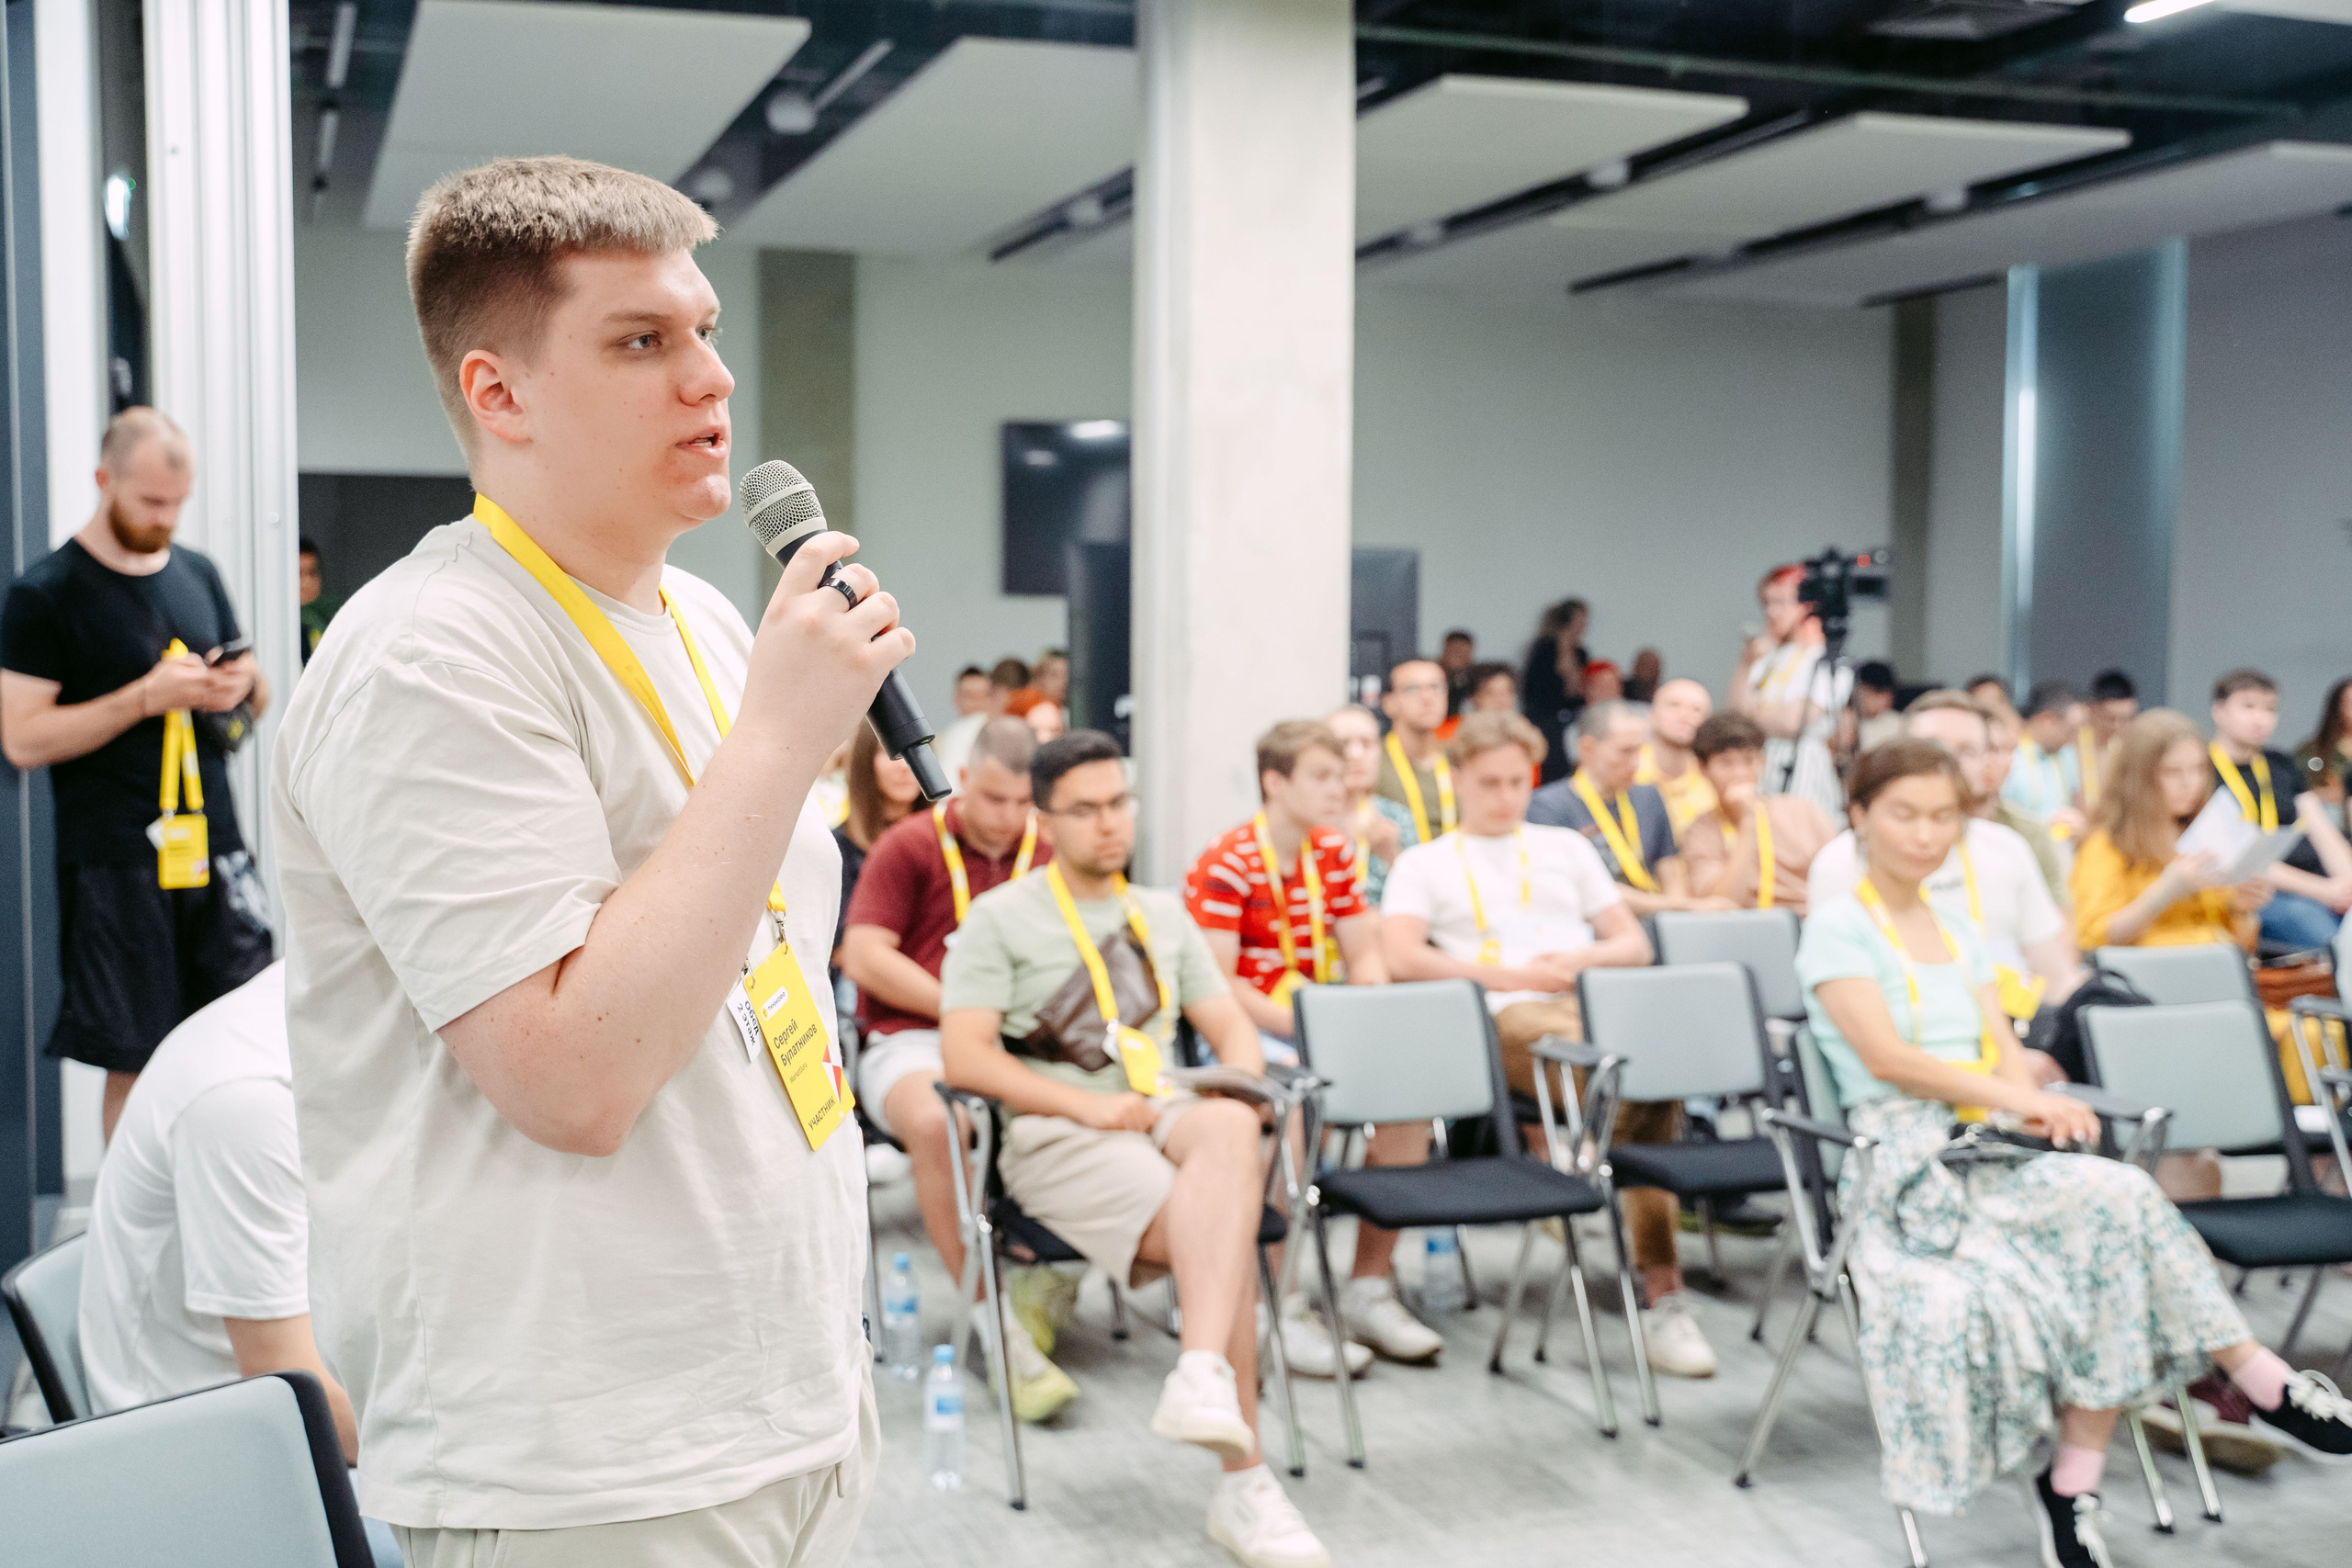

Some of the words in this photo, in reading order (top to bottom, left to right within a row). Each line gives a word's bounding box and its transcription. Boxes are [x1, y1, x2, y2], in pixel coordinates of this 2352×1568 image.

[738, 1003, 743, 1013] 2
[742, 1013, 756, 1046] этаж
[745, 1000, 759, 1036] Обед
[774, 1019, 798, 1050] Сергей
[780, 1023, 818, 1067] Булатников
[808, 1096, 836, 1131] УЧАСТНИК
